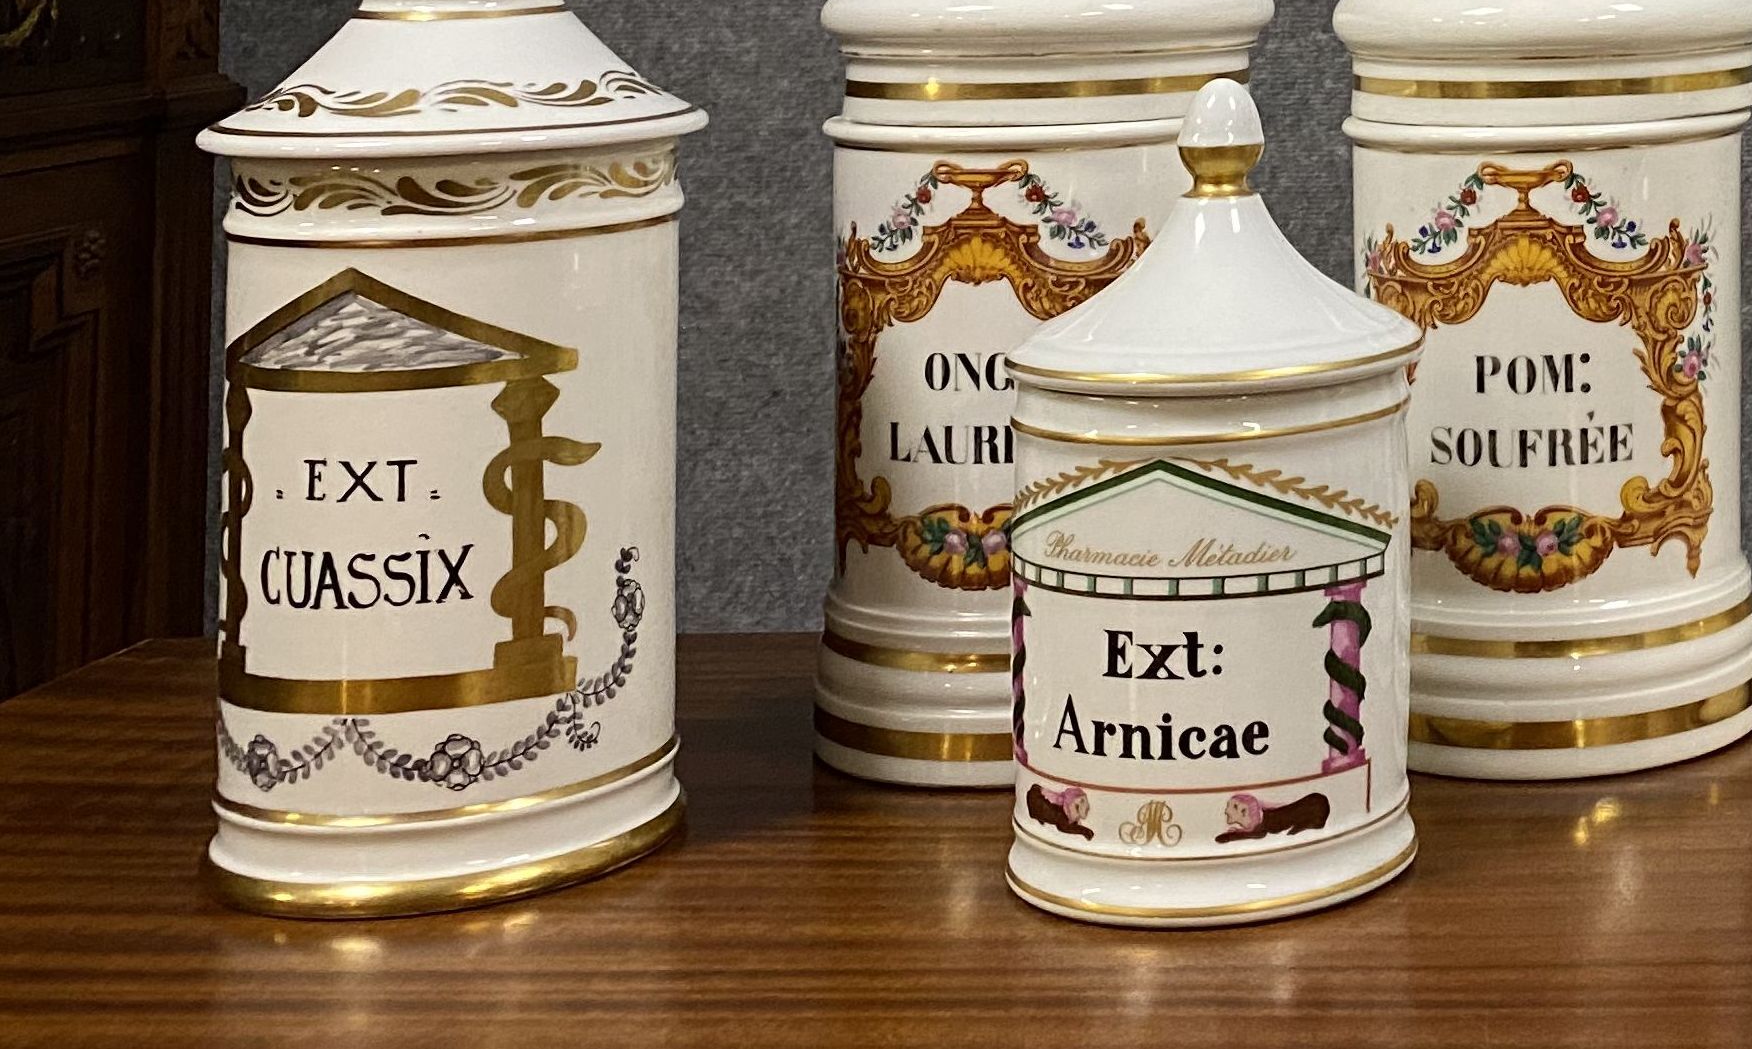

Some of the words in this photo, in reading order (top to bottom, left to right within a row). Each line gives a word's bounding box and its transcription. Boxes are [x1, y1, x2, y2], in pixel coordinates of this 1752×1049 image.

[1474, 353, 1591, 395] POM:
[1430, 410, 1634, 469] SOUFRÉE
[1044, 529, 1162, 568] Pharmacie
[1167, 537, 1297, 568] Métadier
[1102, 629, 1223, 680] Ext:
[1053, 693, 1270, 761] Arnicae
